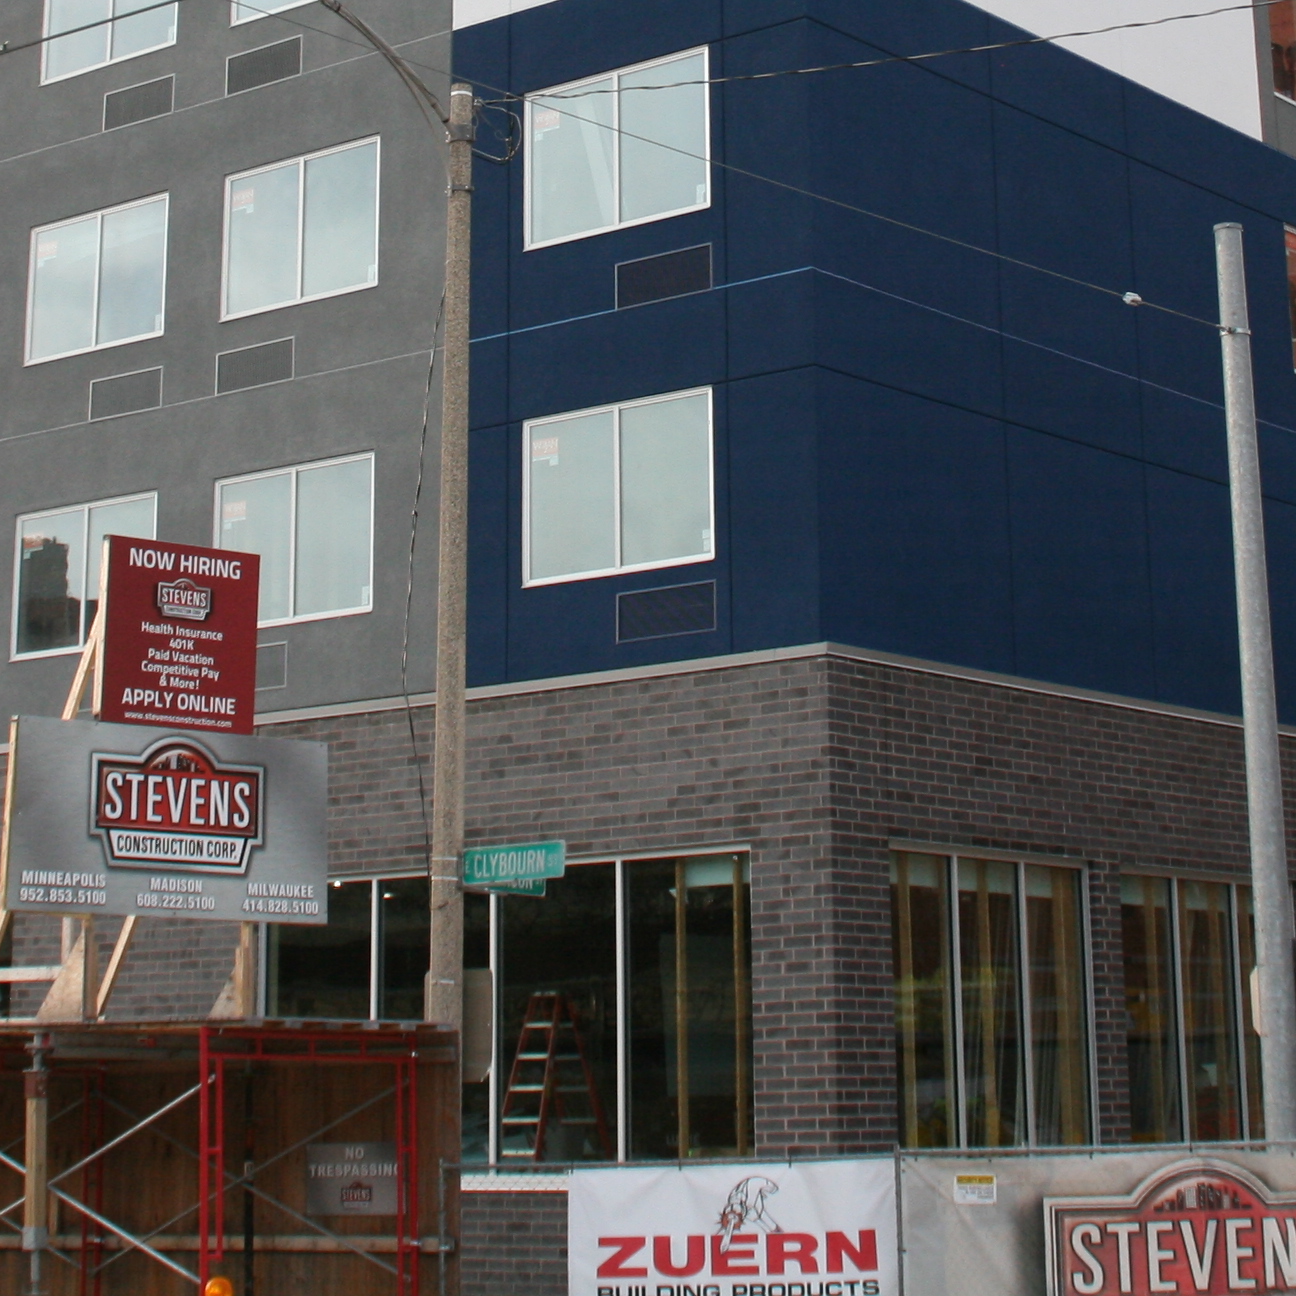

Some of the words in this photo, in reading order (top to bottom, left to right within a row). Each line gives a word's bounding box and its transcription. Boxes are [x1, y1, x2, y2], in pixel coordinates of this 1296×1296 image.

[129, 547, 176, 571] NOW
[180, 554, 242, 580] HIRING
[161, 588, 207, 608] STEVENS
[141, 621, 174, 635] Health
[176, 625, 223, 642] Insurance
[169, 638, 195, 650] 401K
[148, 648, 170, 661] Paid
[172, 651, 214, 666] Vacation
[141, 661, 199, 677] Competitive
[201, 668, 220, 682] Pay
[170, 676, 200, 690] More!
[121, 687, 174, 709] APPLY
[177, 693, 237, 715] ONLINE
[104, 772, 251, 829] STEVENS
[117, 835, 204, 857] CONSTRUCTION
[206, 839, 238, 860] CORP.
[473, 849, 546, 878] CLYBOURN
[21, 870, 106, 888] MINNEAPOLIS
[150, 877, 203, 893] MADISON
[19, 888, 106, 905] 952.853.5100
[247, 882, 314, 898] MILWAUKEE
[136, 894, 215, 911] 608.222.5100
[241, 898, 319, 915] 414.828.5100
[345, 1146, 365, 1160] NO
[596, 1228, 879, 1279] ZUERN
[732, 1279, 881, 1296] PRODUCTS
